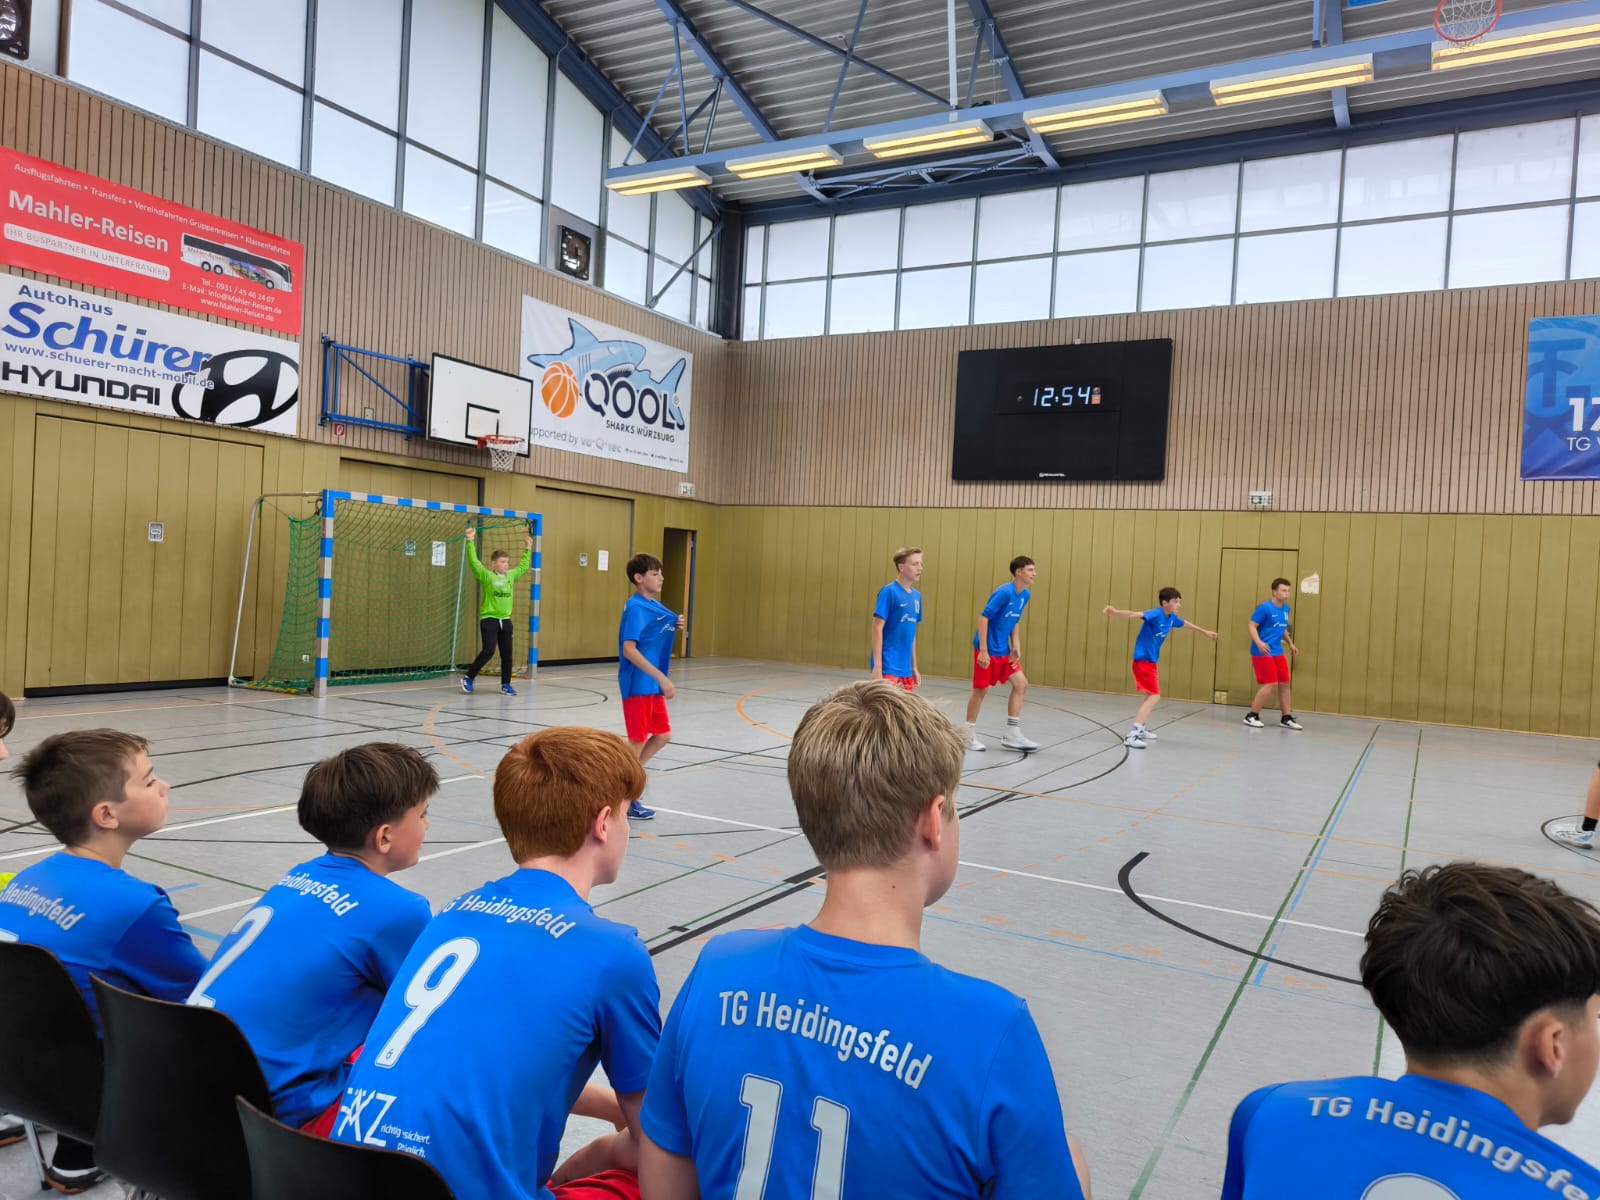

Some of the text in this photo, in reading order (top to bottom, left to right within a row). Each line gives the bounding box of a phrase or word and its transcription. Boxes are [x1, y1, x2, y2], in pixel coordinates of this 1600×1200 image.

[9, 189, 169, 253] Mahler-Reisen
[14, 163, 82, 190] Ausflugsfahrten
[91, 187, 126, 205] Transfers
[134, 201, 188, 225] Vereinsfahrten
[190, 215, 239, 240] Gruppenreisen
[6, 226, 24, 239] IHR
[26, 233, 87, 255] BUSPARTNER
[89, 250, 99, 259] IN
[101, 254, 169, 277] UNTERFRANKEN
[18, 284, 114, 316] Autohaus
[216, 282, 232, 293] 0931
[1, 301, 213, 373] Schürer
[2, 361, 160, 406] HYUNDAI
[5, 342, 215, 390] www.schuerer-macht-mobil.de
[584, 371, 676, 430] QOOL
[1033, 385, 1091, 407] 12:54
[568, 433, 579, 446] by
[605, 419, 675, 444] SHARKS WÜRZBURG
[1567, 436, 1592, 452] TG
[457, 894, 576, 939] Heidingsfeld
[374, 936, 481, 1069] 9
[719, 990, 933, 1090] TG Heidingsfeld
[733, 1072, 851, 1200] 11
[1308, 1096, 1353, 1118] TG
[1365, 1098, 1600, 1200] Heidingsfe
